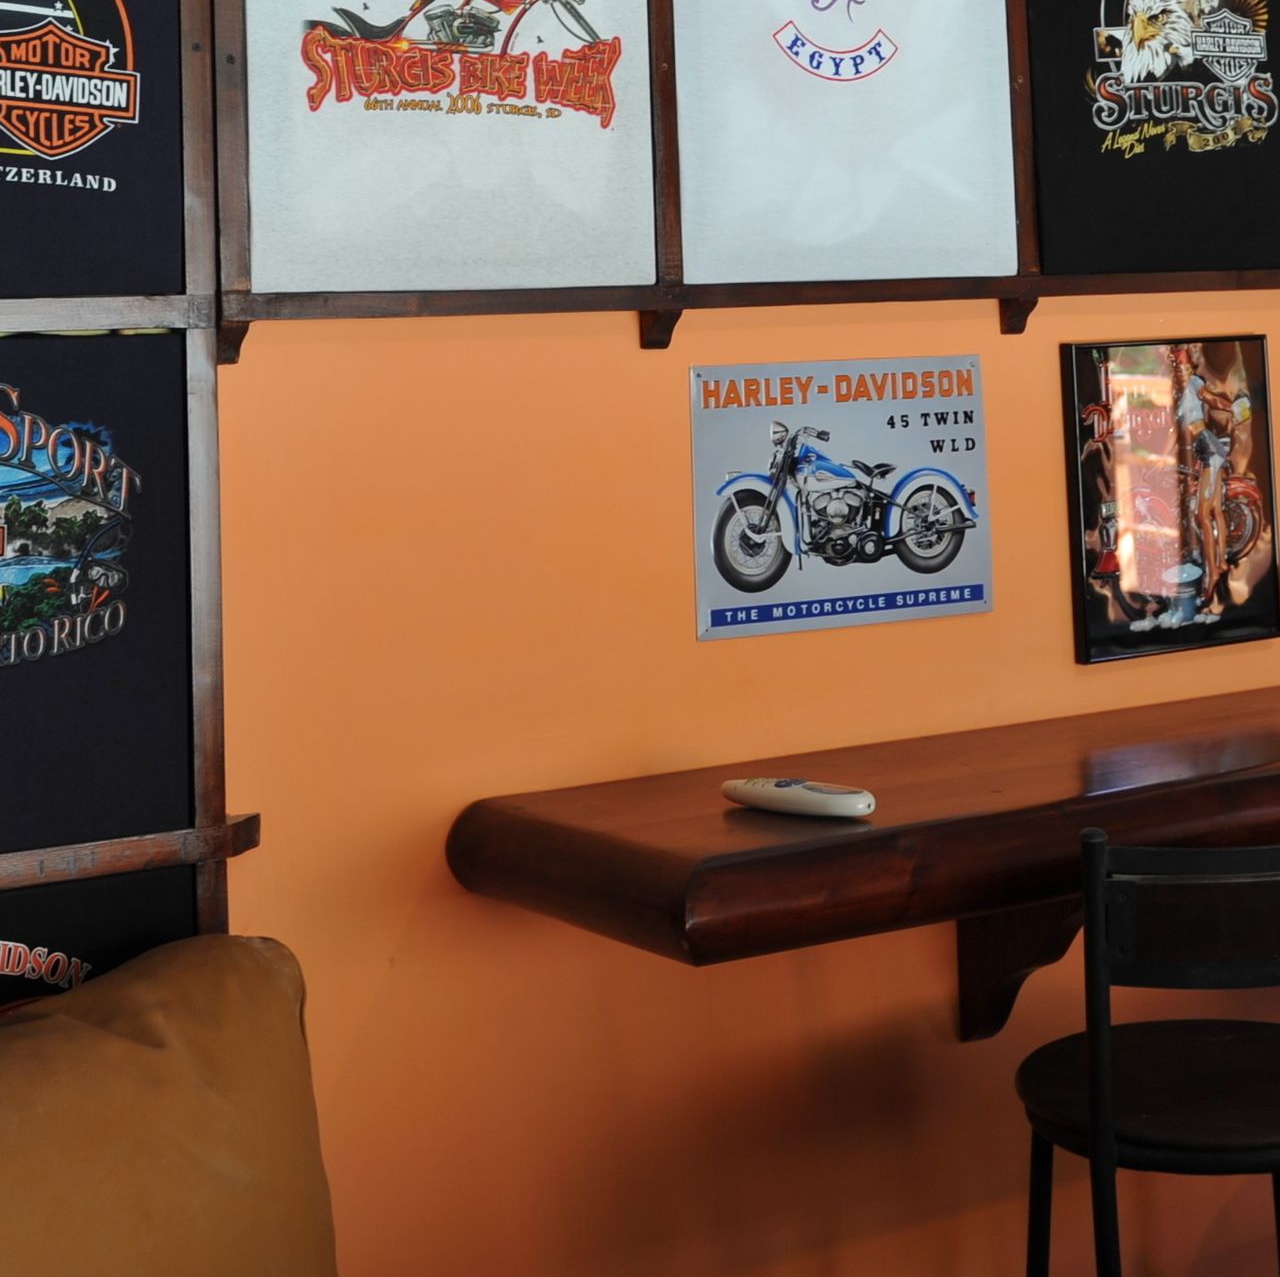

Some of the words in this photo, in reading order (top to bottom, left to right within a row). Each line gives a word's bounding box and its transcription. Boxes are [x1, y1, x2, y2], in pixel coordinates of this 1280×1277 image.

[10, 36, 91, 69] MOTOR
[786, 33, 886, 76] EGYPT
[301, 24, 456, 112] STURGIS
[459, 51, 530, 100] BIKE
[533, 36, 622, 129] WEEK
[396, 97, 443, 112] ANNUAL
[445, 93, 482, 116] 2006
[1092, 72, 1279, 131] STURGIS
[11, 110, 91, 146] CYCLES
[887, 414, 910, 429] 45
[921, 410, 975, 428] TWIN
[930, 438, 976, 454] WLD
[725, 609, 759, 622] THE
[773, 596, 886, 619] MOTORCYCLE
[896, 588, 972, 606] SUPREME
[49, 600, 127, 654] RICO
